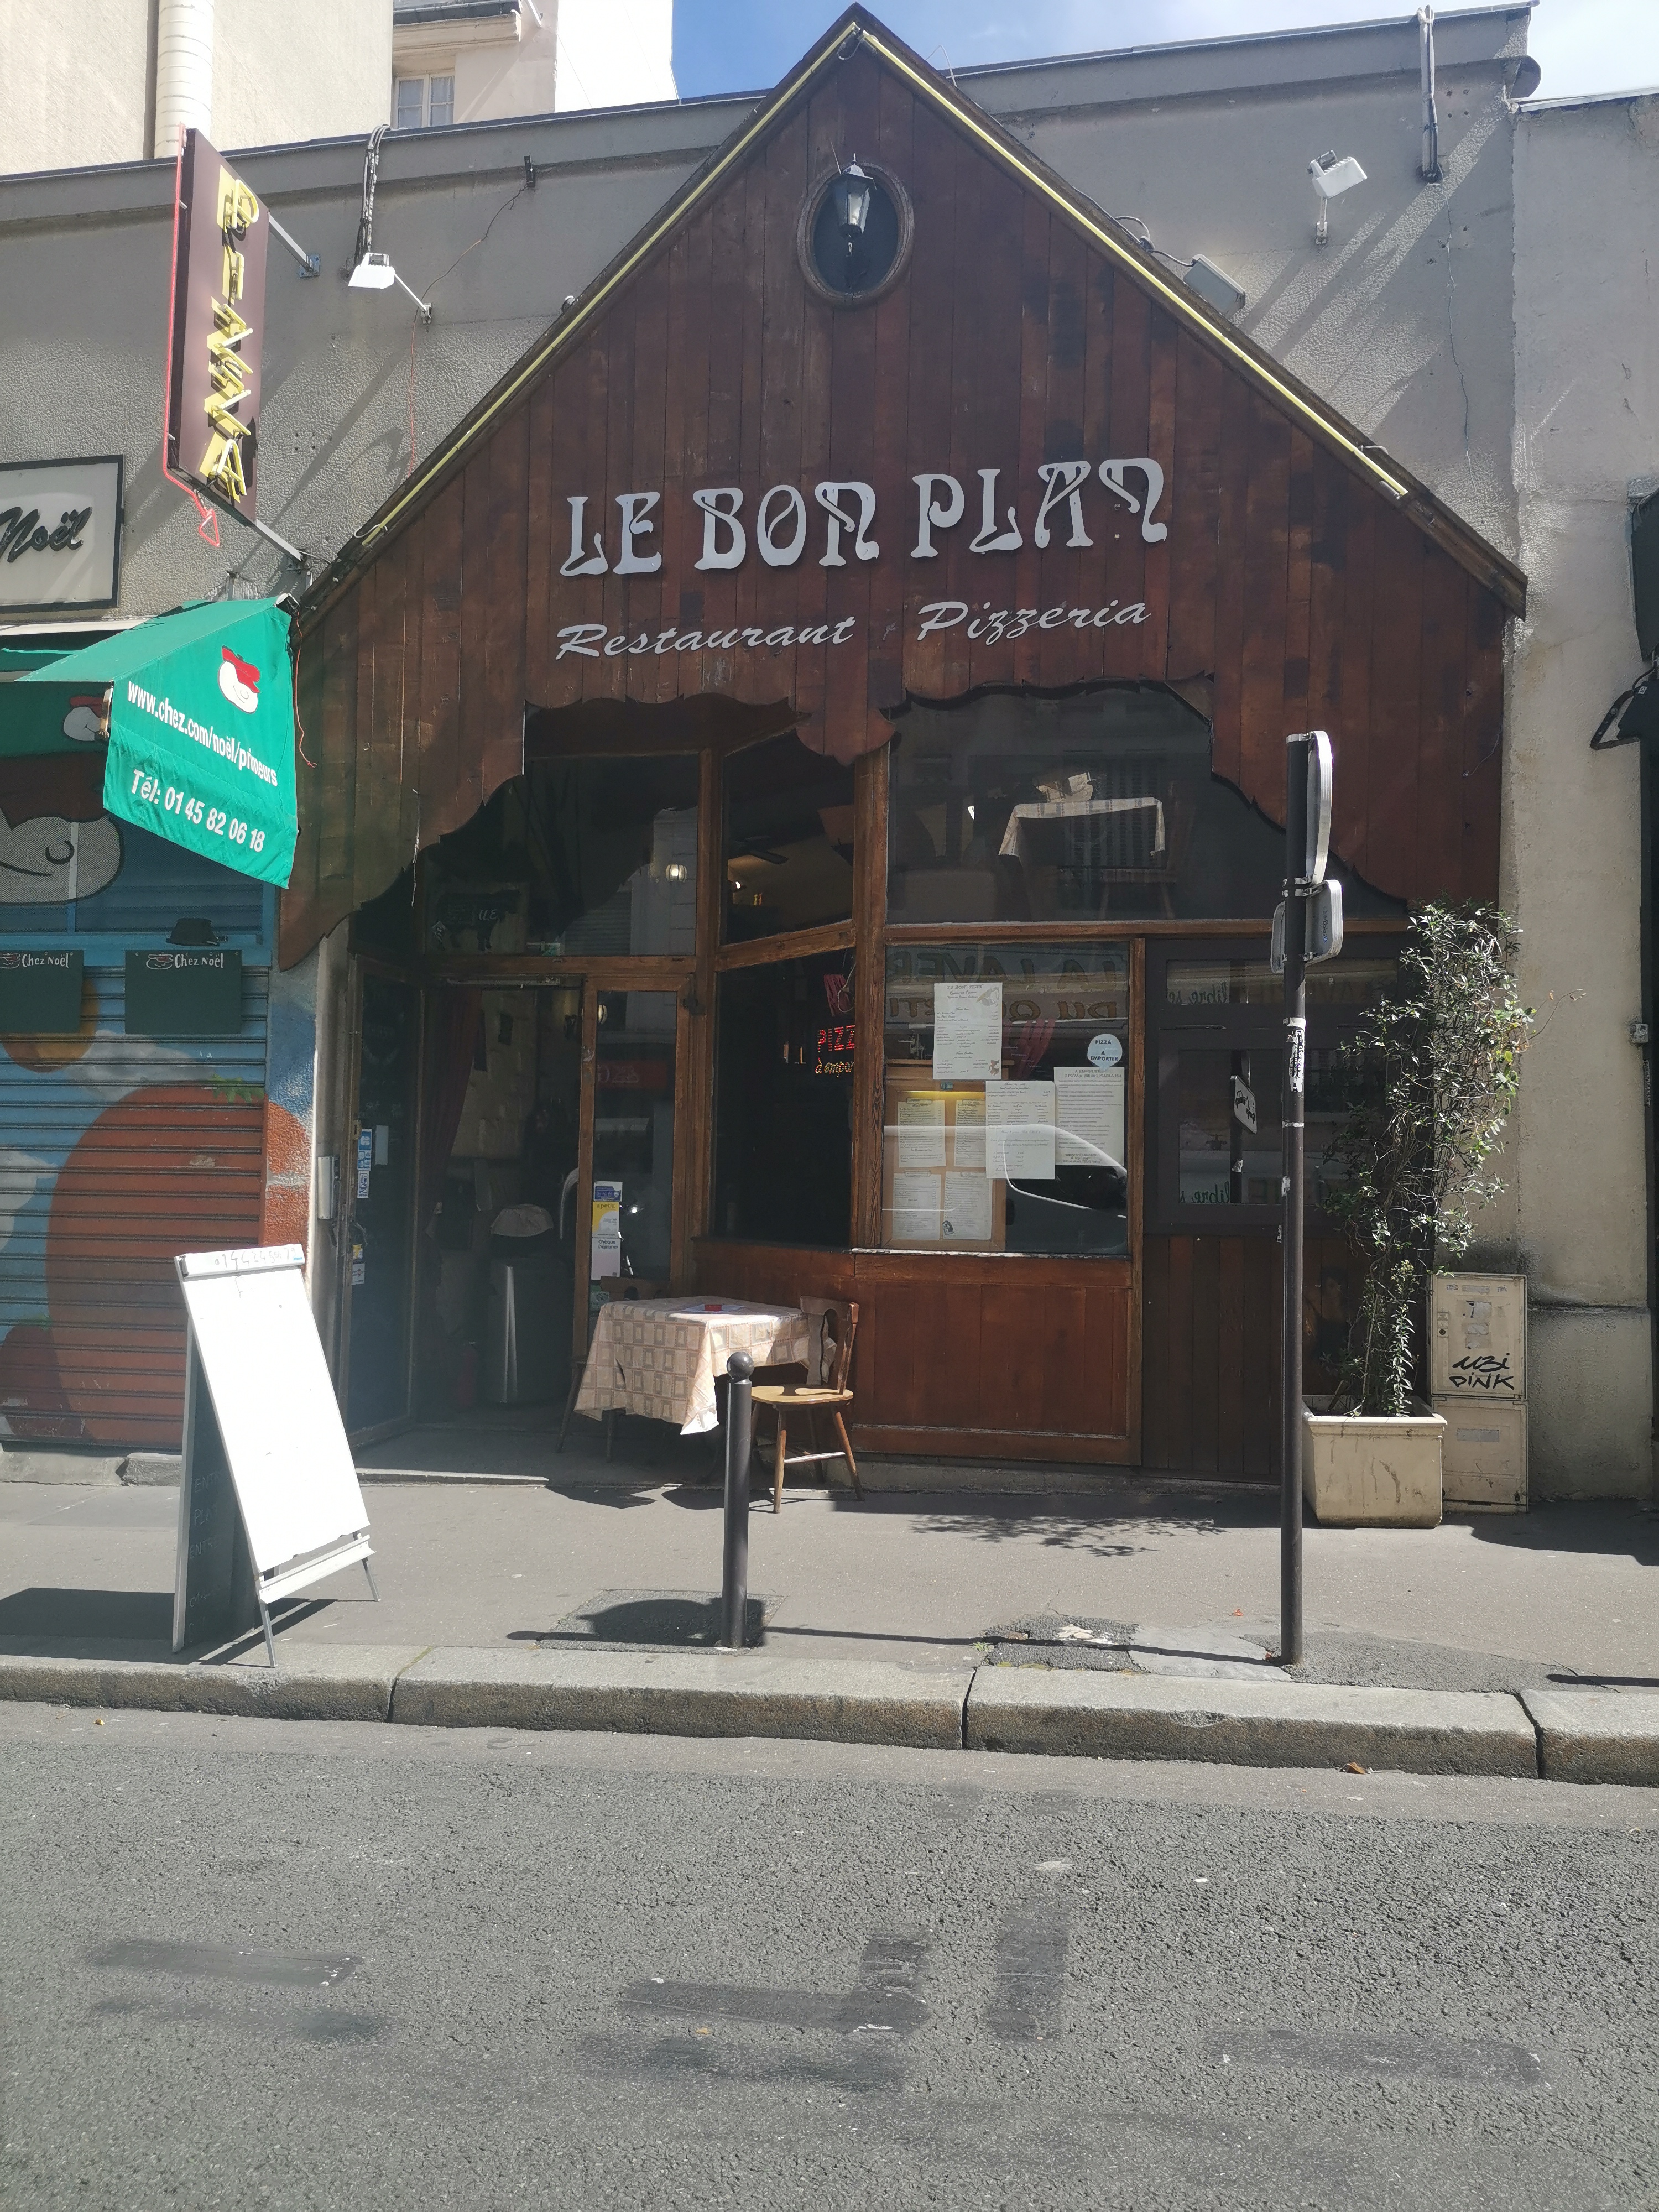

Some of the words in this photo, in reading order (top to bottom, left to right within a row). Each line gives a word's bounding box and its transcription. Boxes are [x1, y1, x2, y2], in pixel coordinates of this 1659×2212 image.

[199, 164, 259, 503] PIZZA
[0, 506, 92, 564] Noël
[560, 492, 662, 577] LE
[692, 482, 880, 570] BON
[910, 458, 1168, 559] PLAN
[555, 616, 856, 660] Restaurant
[916, 599, 1152, 646] Pizzeria
[165, 786, 183, 815] 01
[185, 797, 205, 824] 45
[206, 808, 227, 836] 82
[229, 818, 248, 844] 06
[249, 828, 265, 852] 18
[22, 953, 45, 967] Chez
[48, 952, 69, 968] Noël
[175, 954, 199, 967] Chez
[201, 952, 224, 968] Noël
